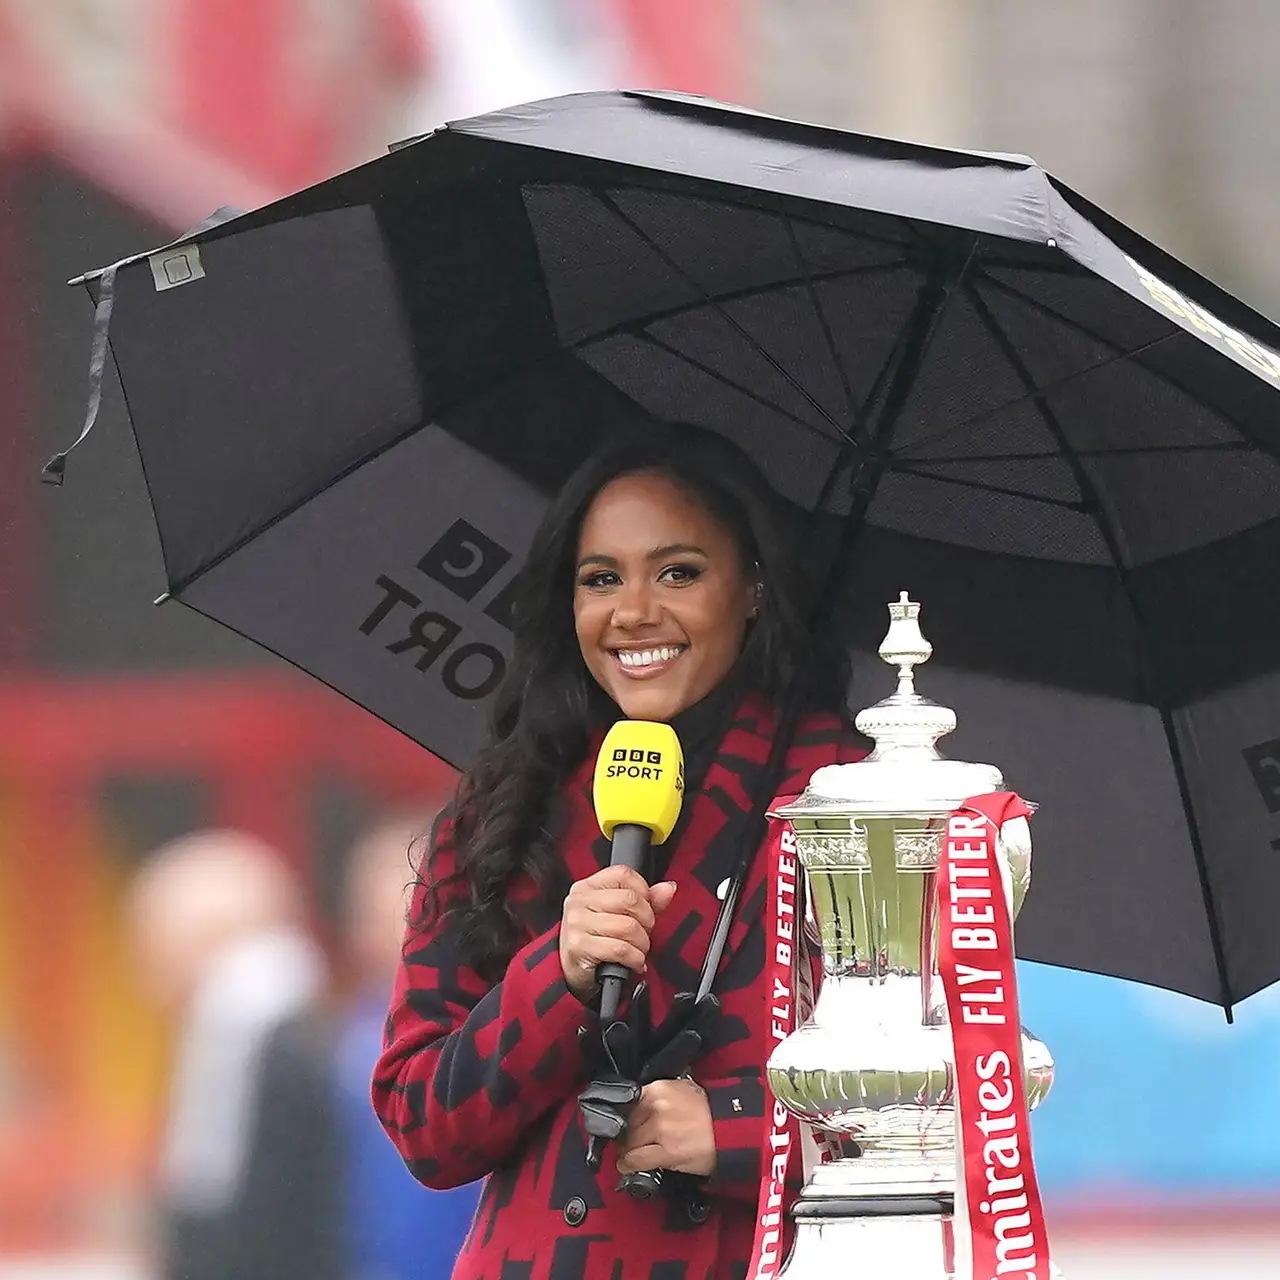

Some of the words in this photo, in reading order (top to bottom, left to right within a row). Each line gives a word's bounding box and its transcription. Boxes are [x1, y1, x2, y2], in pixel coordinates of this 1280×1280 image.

[606, 765, 663, 781] SPORT
[613, 749, 662, 764] BBC
[776, 830, 797, 967] BETTER
[947, 815, 999, 950] BETTER
[772, 977, 791, 1041] FLY
[955, 963, 1006, 1025] FLY
